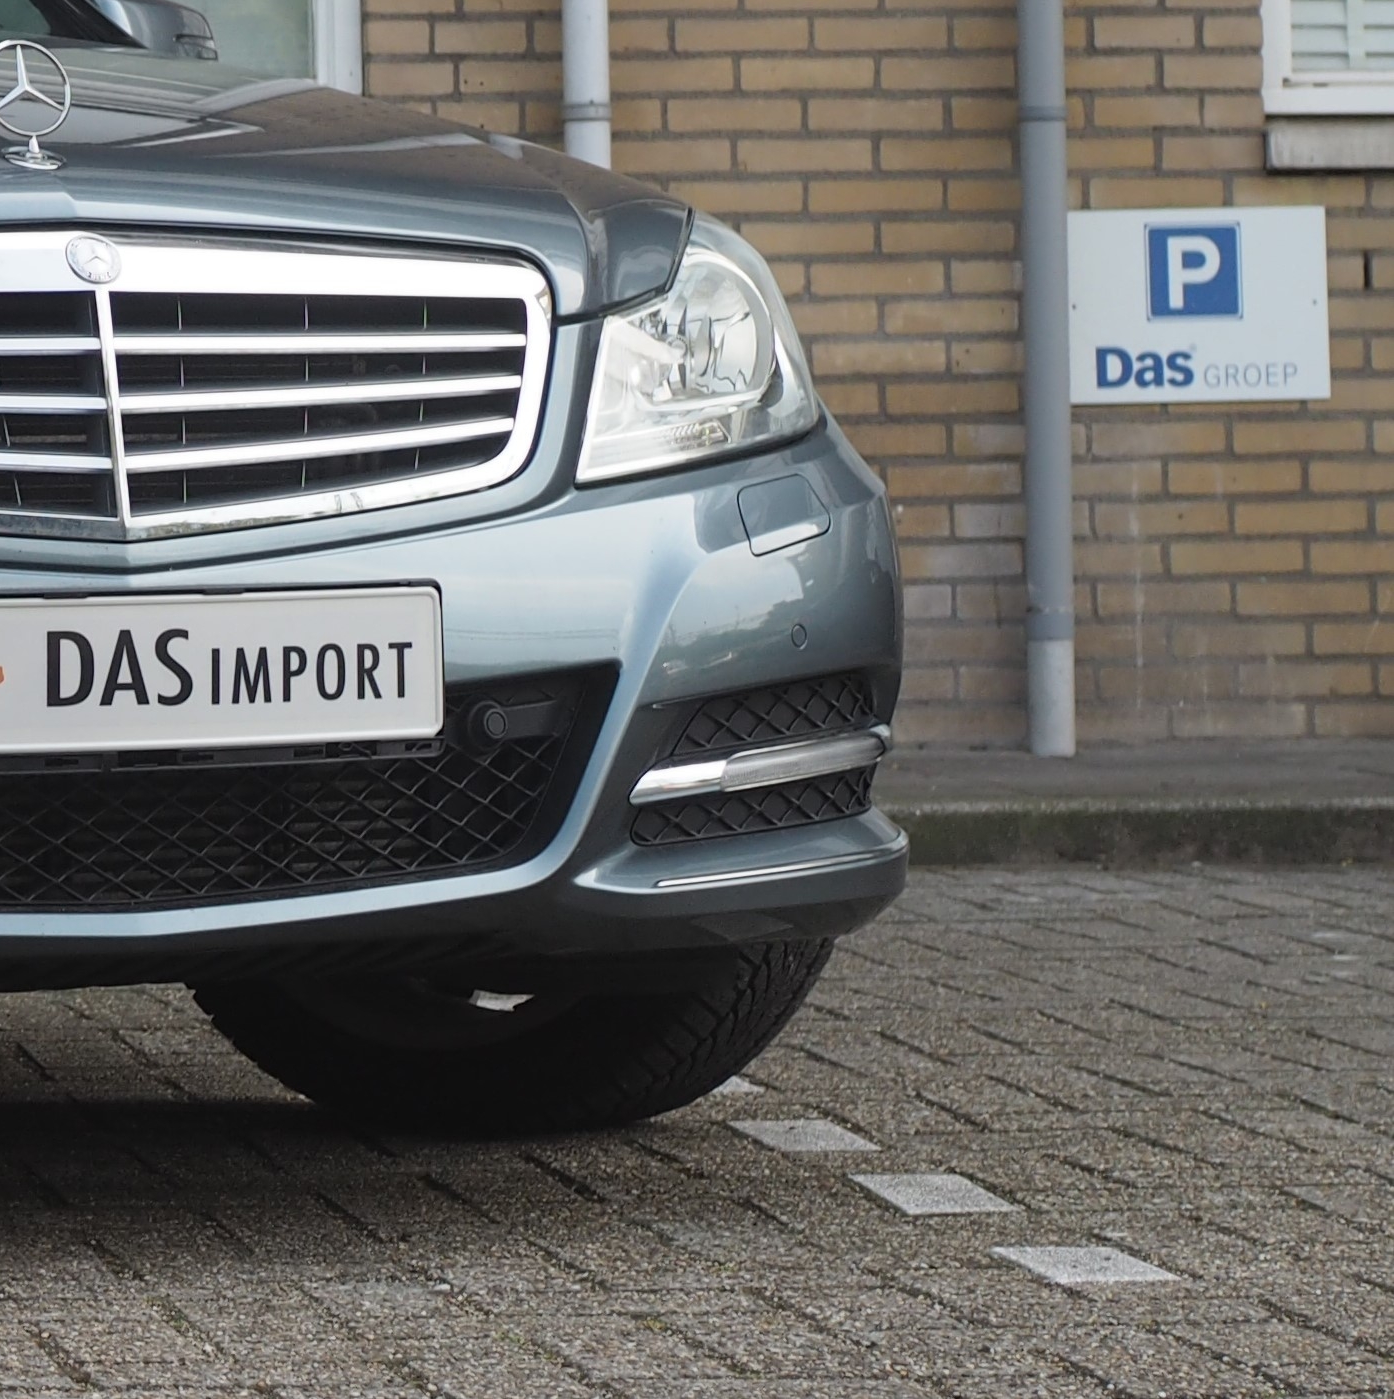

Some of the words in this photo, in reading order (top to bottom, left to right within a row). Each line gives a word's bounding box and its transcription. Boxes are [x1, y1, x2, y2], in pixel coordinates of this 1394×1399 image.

[1167, 236, 1221, 309] P
[1203, 363, 1298, 387] GROEP
[47, 629, 194, 707] DAS
[210, 642, 413, 706] IMPORT
